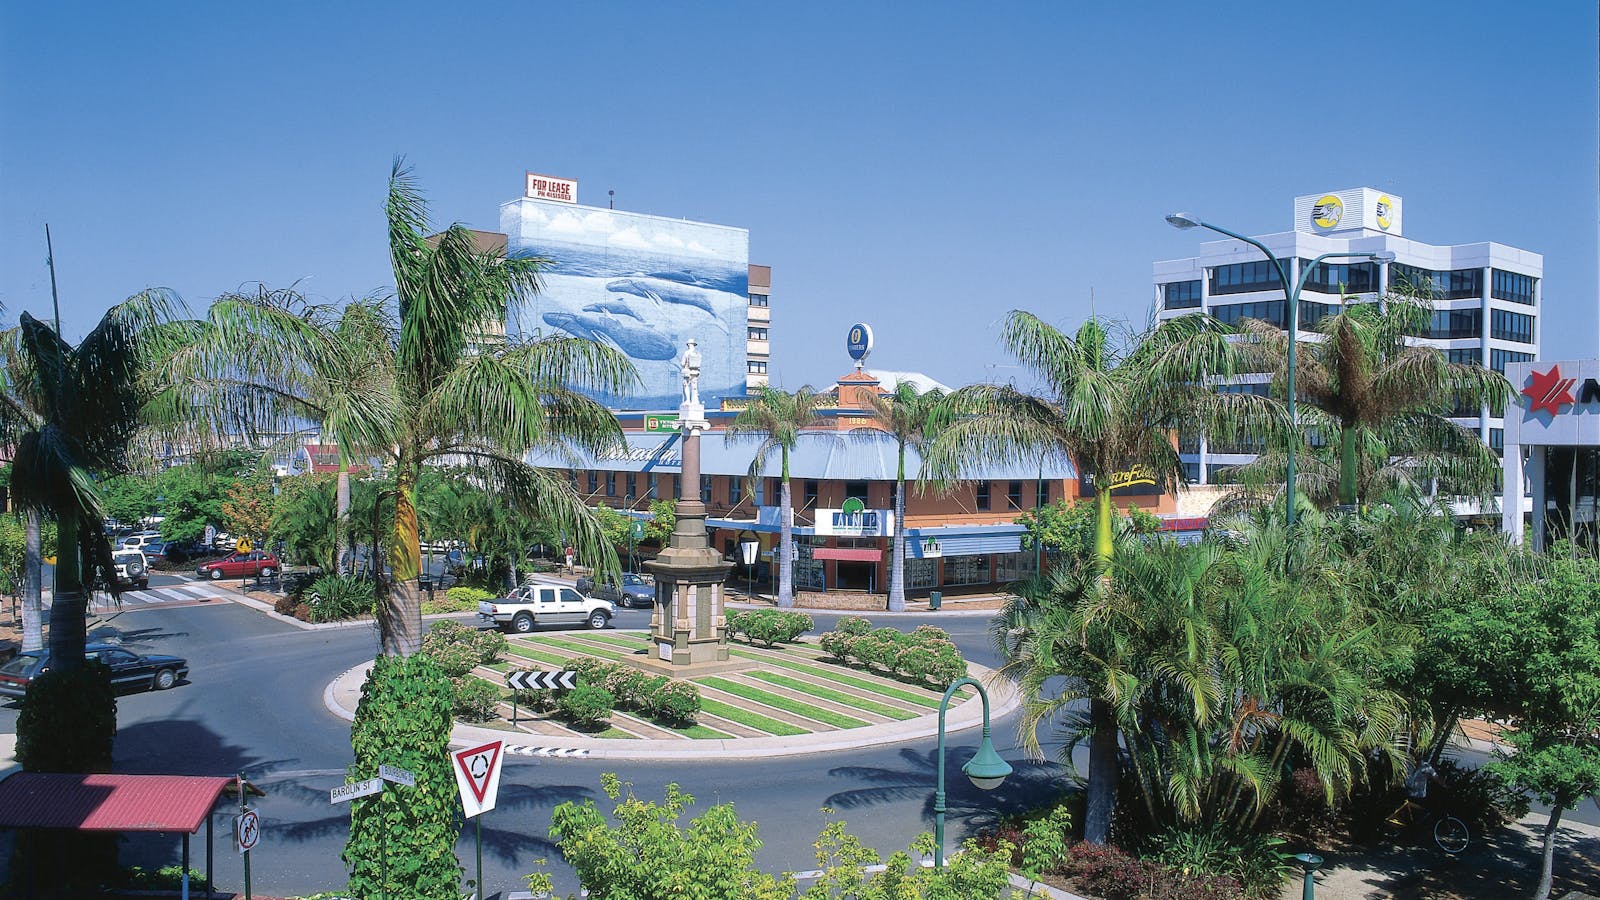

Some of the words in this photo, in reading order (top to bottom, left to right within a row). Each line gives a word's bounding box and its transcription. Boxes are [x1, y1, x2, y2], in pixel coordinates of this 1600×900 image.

[532, 179, 547, 191] FOR
[548, 181, 571, 195] LEASE
[332, 784, 360, 799] BAROLIN
[363, 780, 371, 791] ST
